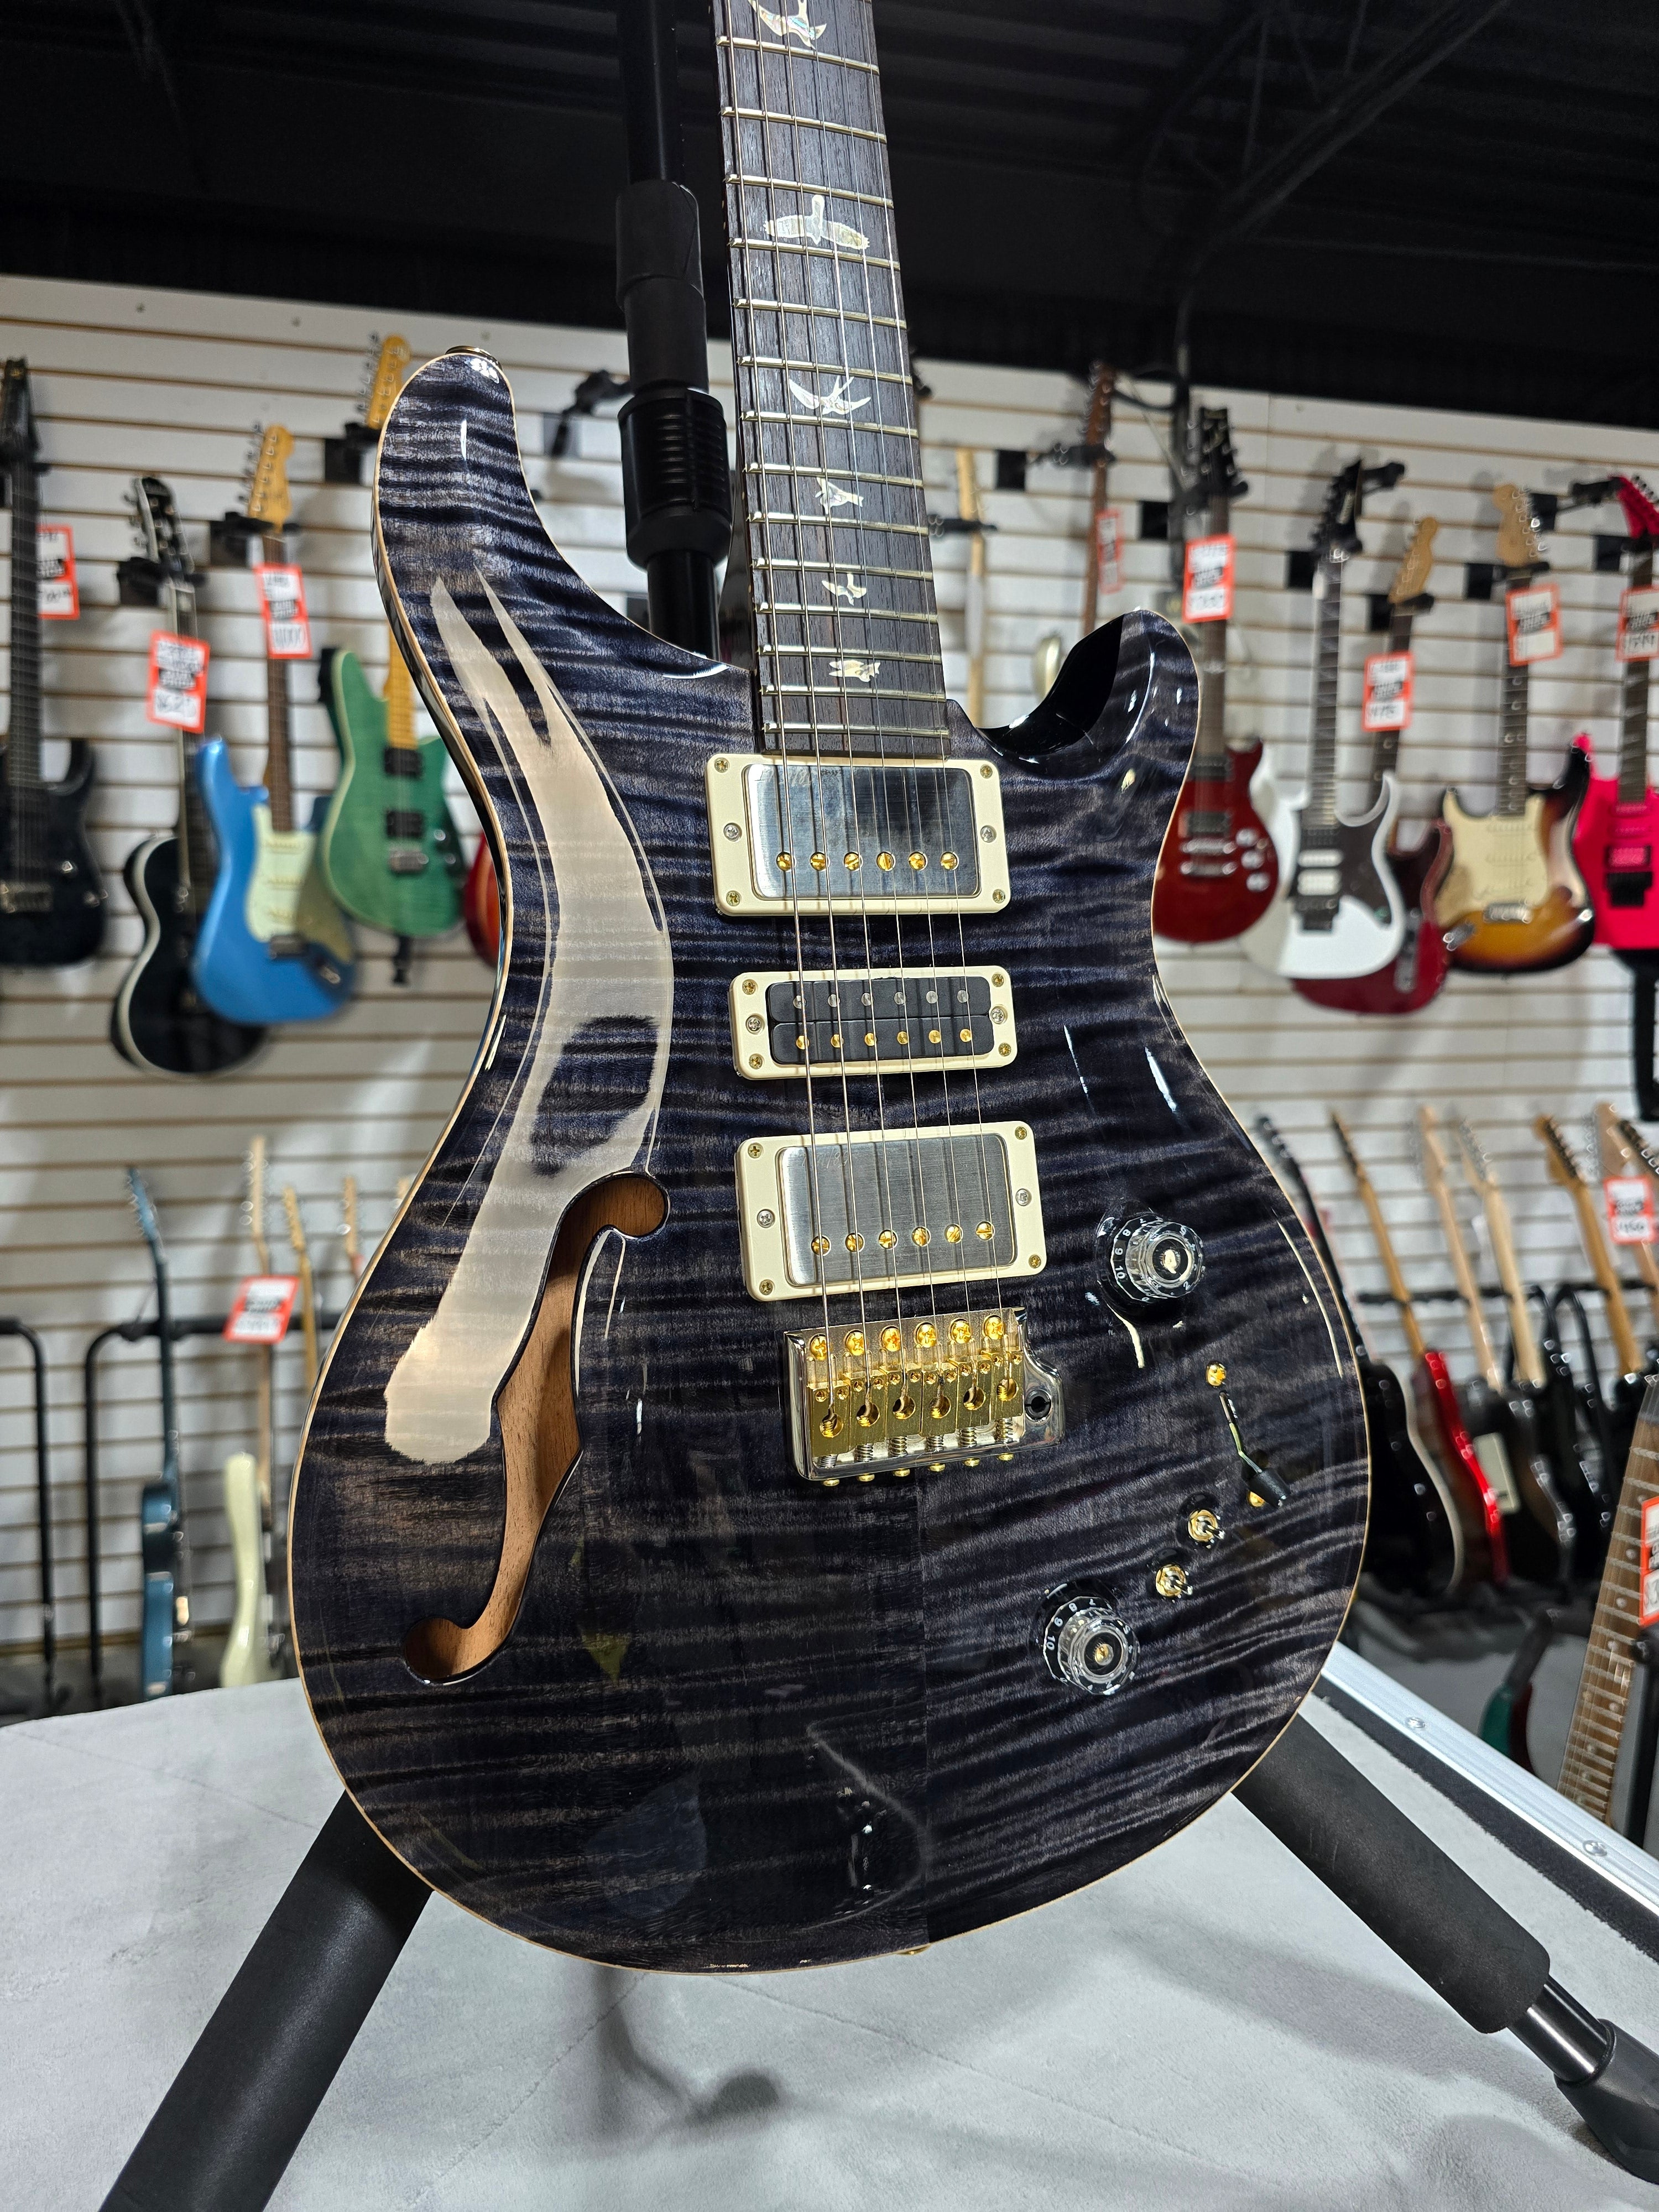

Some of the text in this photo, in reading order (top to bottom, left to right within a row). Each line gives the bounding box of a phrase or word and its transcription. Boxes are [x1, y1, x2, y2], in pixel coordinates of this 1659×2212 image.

[1115, 1265, 1125, 1279] 10
[1068, 1603, 1077, 1612] 8
[1053, 1617, 1063, 1627] 9
[1046, 1635, 1056, 1651] 10
